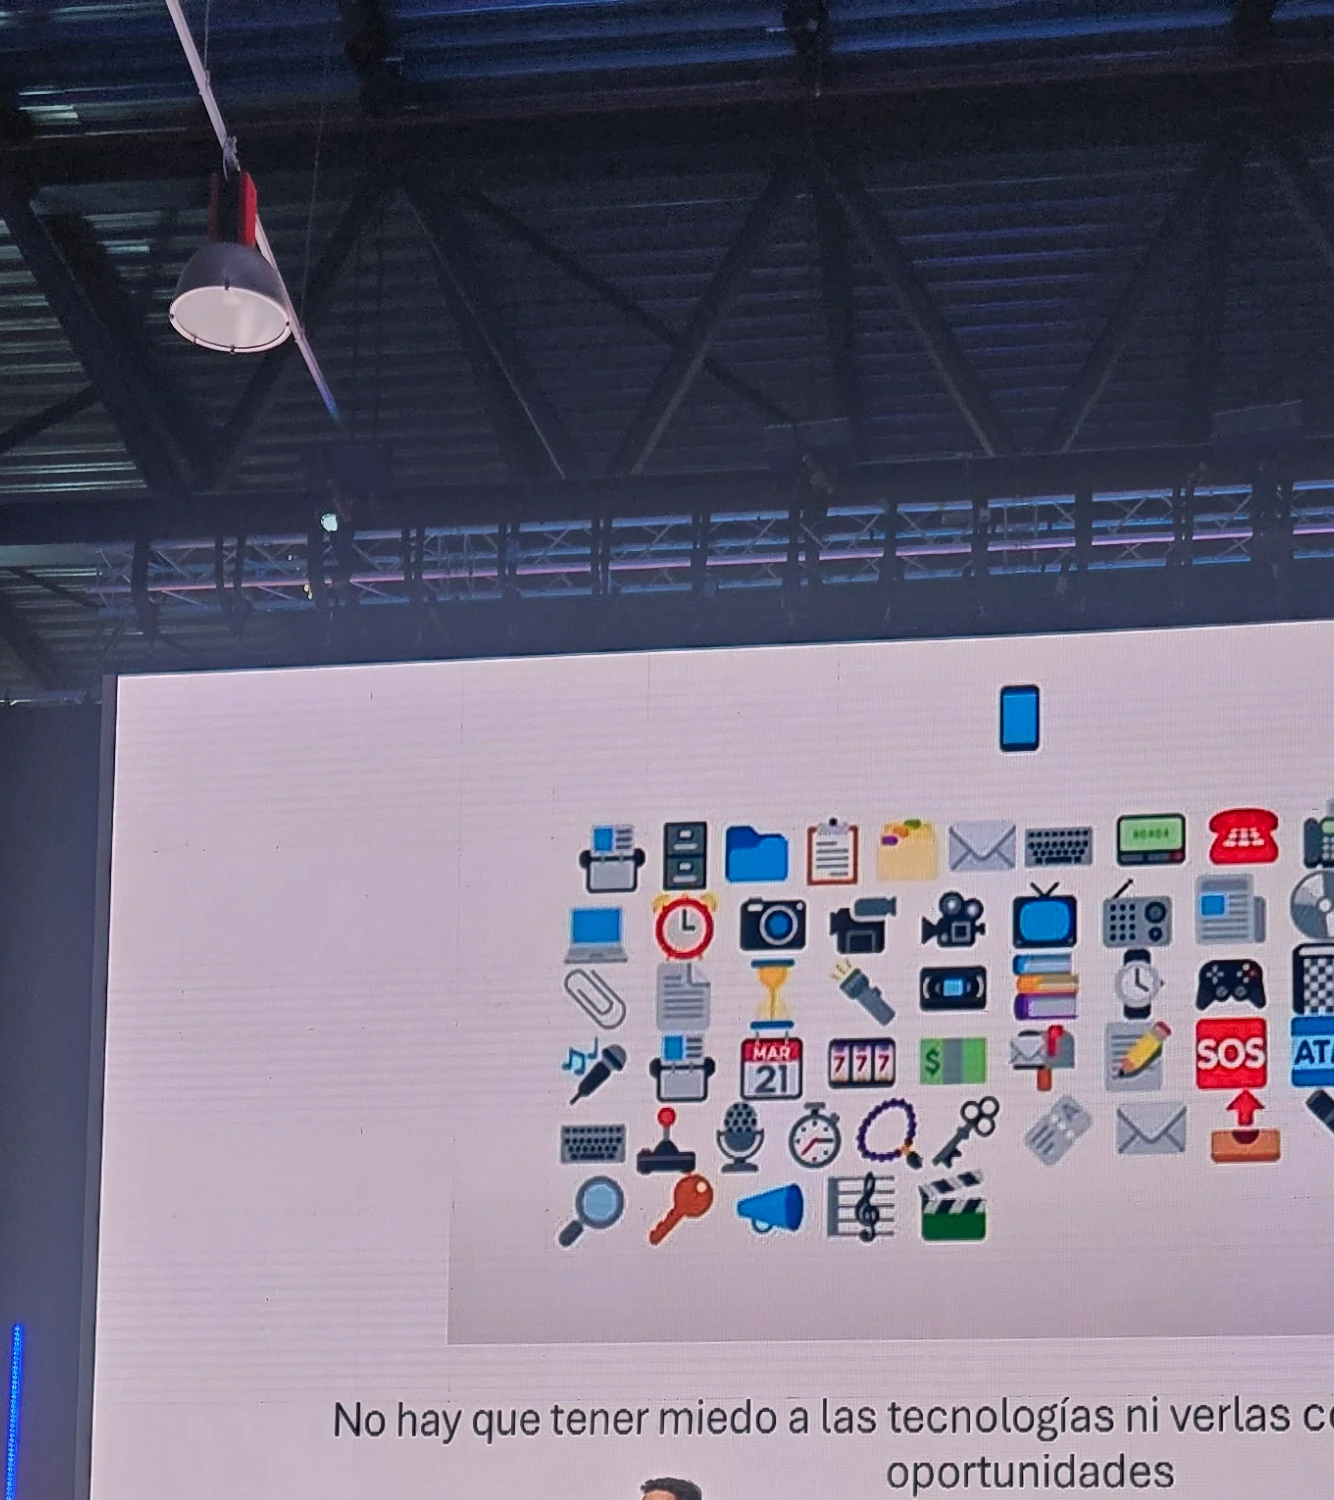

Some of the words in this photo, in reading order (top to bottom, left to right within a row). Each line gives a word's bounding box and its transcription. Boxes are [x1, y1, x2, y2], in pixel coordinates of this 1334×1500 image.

[753, 1045, 791, 1061] MAR
[1197, 1038, 1266, 1069] SOS
[755, 1065, 788, 1094] 21
[334, 1401, 386, 1437] No
[398, 1400, 461, 1445] hay
[473, 1409, 540, 1445] que
[551, 1404, 649, 1436] tener
[659, 1398, 777, 1435] miedo
[789, 1406, 808, 1434] a
[823, 1397, 877, 1434] las
[888, 1393, 1114, 1442] tecnologías
[1127, 1395, 1158, 1433] ni
[1170, 1394, 1291, 1432] verlas
[887, 1452, 1174, 1498] oportunidades
